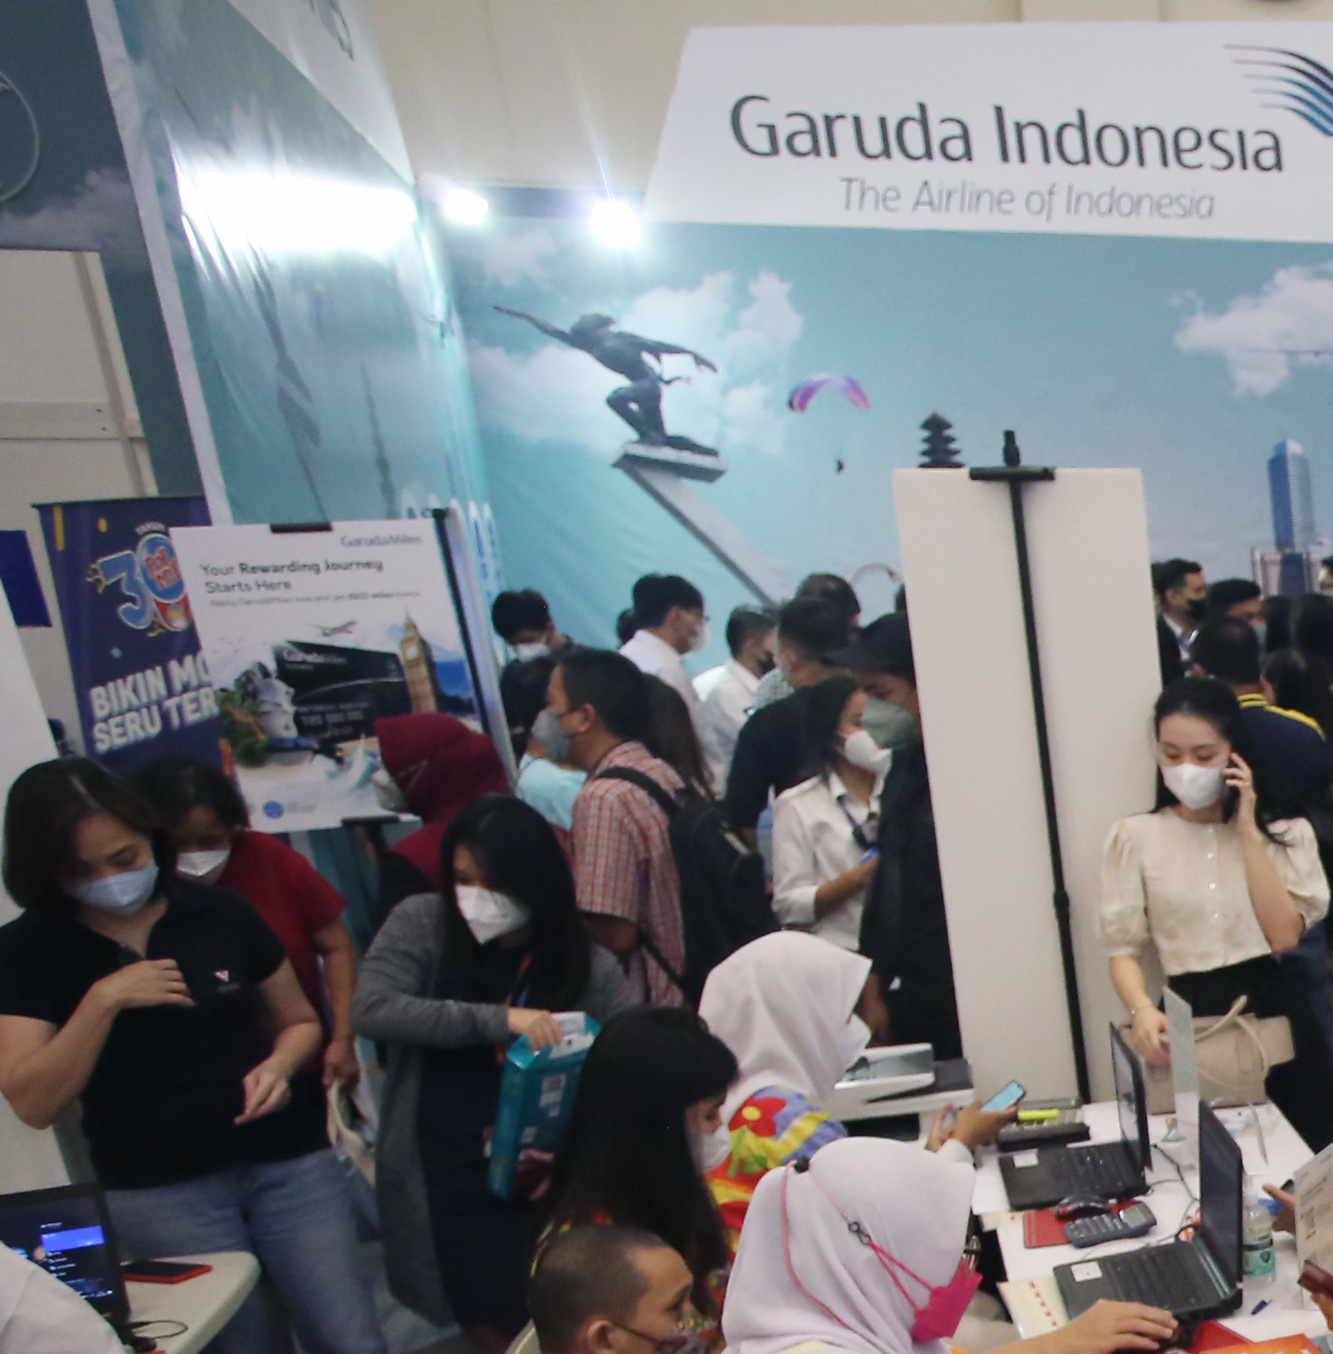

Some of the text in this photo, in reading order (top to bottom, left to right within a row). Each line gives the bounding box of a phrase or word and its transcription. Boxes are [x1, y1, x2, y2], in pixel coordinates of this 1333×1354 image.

[731, 95, 1283, 172] Garuda Indonesia
[840, 176, 1215, 221] The Airline of Indonesia
[202, 559, 384, 576] Your Rewarding Journey
[205, 579, 292, 593] Starts Here
[90, 665, 167, 719] BIKIN
[93, 704, 162, 753] SERU
